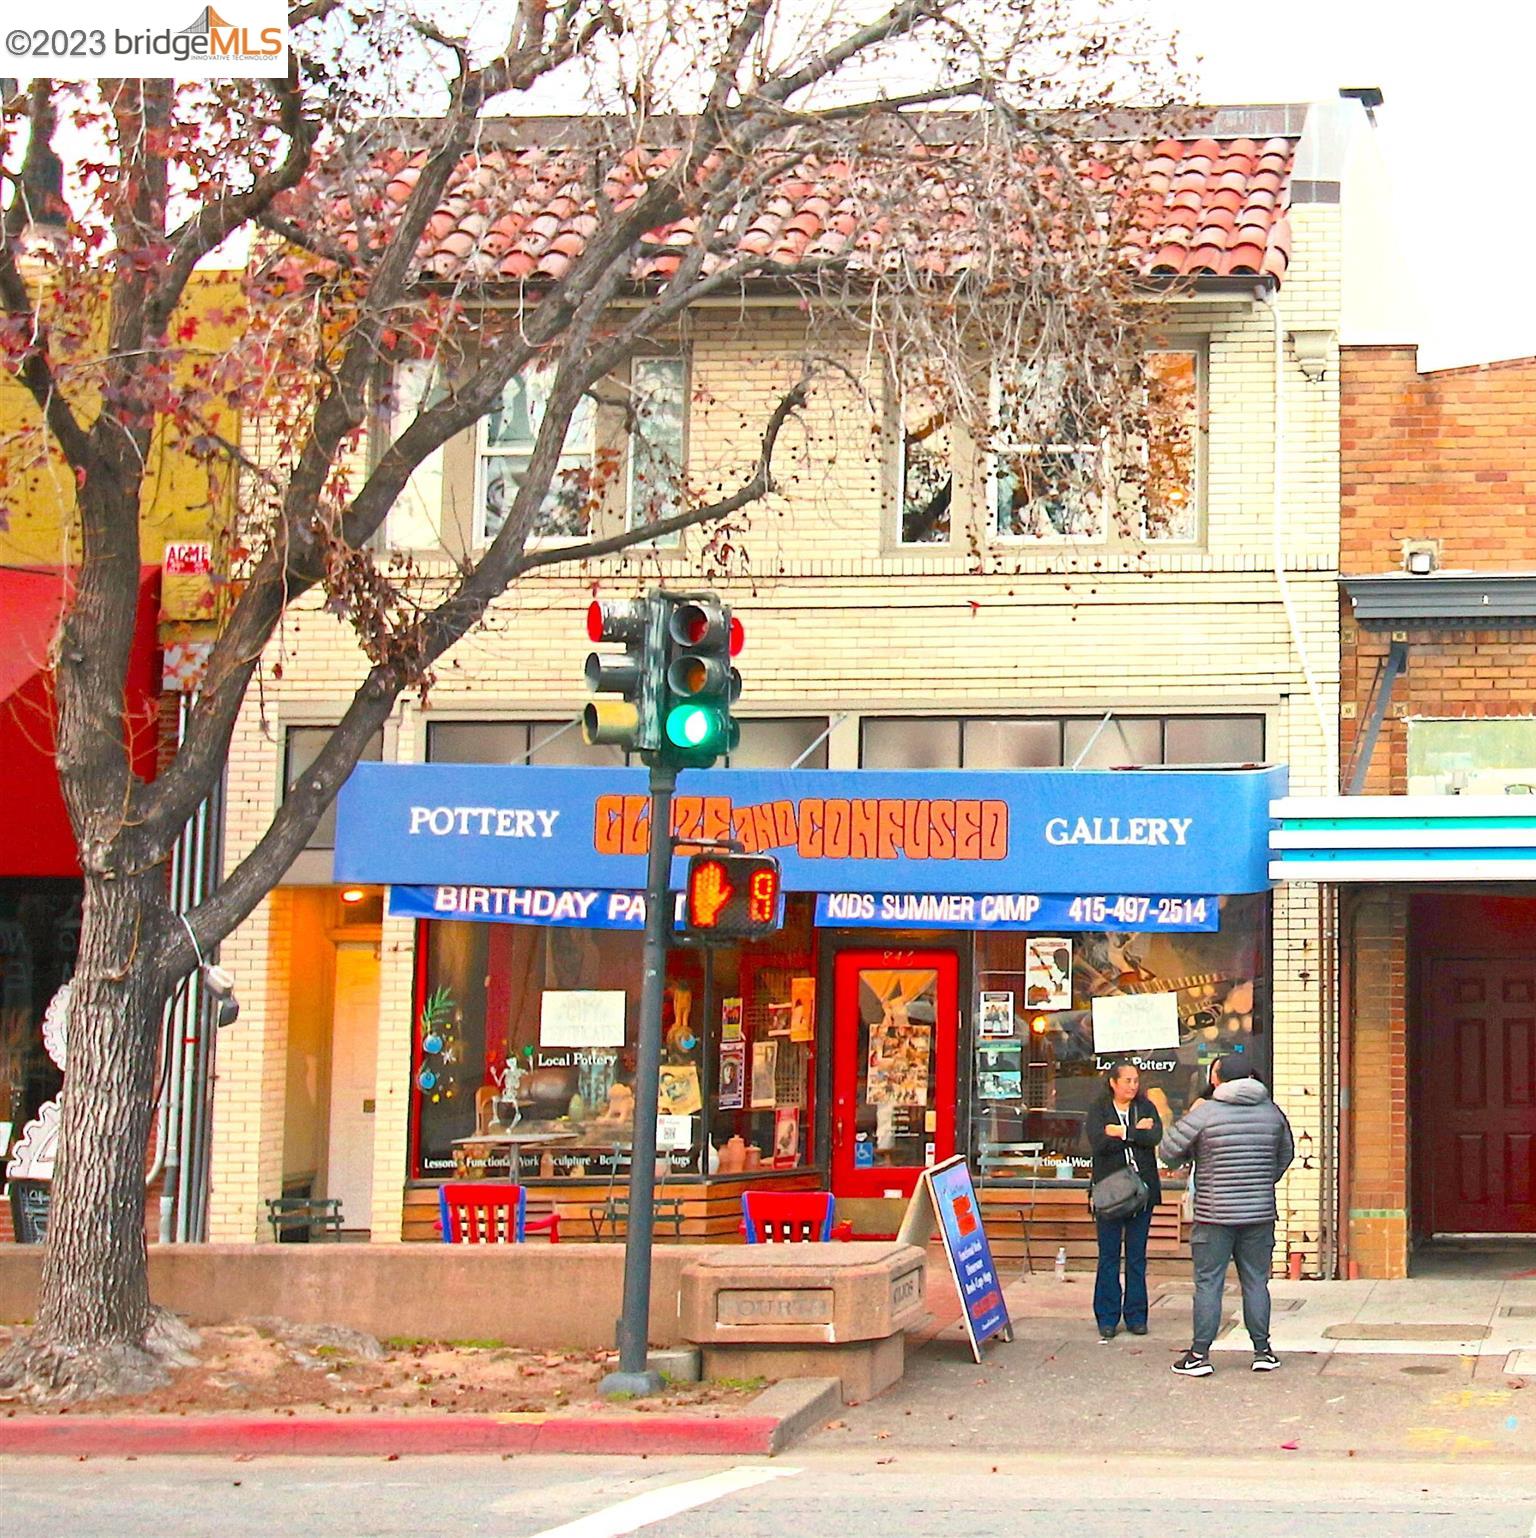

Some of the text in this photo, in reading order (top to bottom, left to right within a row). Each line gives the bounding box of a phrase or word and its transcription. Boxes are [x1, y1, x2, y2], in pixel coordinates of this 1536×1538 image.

[409, 806, 560, 839] POTTERY
[594, 794, 732, 857] GLZE
[797, 798, 1009, 861] CONFUSED
[1045, 817, 1193, 847] GALLERY
[435, 887, 599, 921] BIRTHDAY
[828, 893, 1206, 924] KIDS SUMMER CAMP 415-497-2514
[538, 1052, 618, 1068] Local Pottery
[1132, 1056, 1177, 1072] Pottery
[466, 1156, 511, 1168] Functiona
